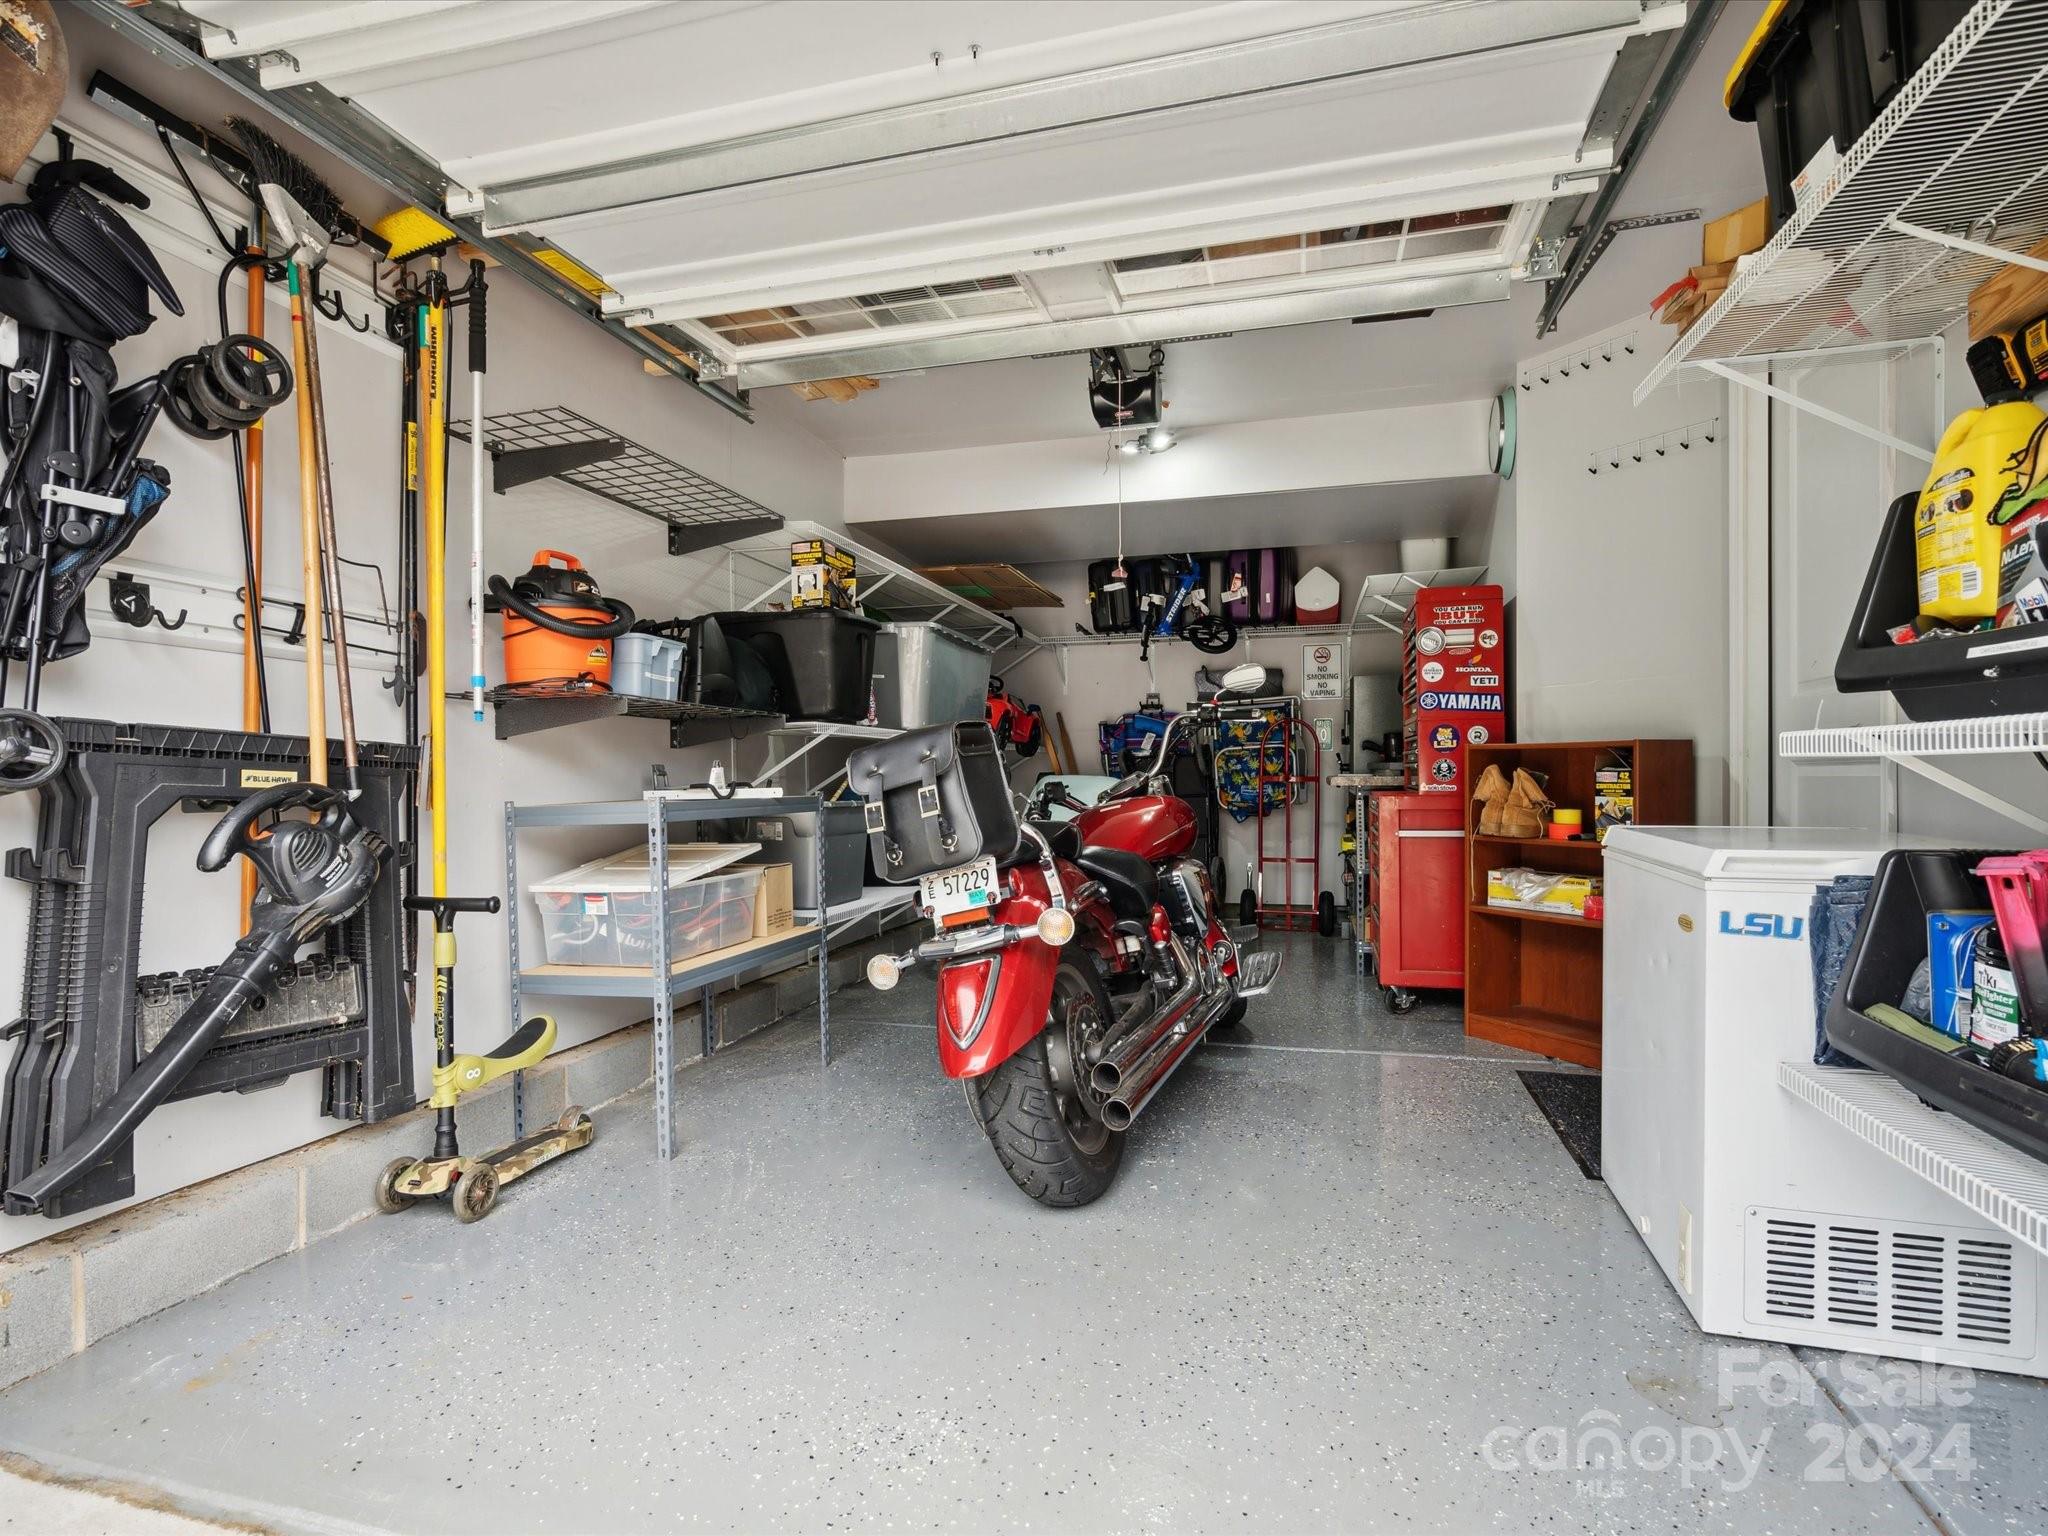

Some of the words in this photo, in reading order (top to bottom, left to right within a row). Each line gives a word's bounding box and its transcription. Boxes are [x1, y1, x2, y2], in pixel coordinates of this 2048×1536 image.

[1165, 587, 1187, 623] STRIDER
[2019, 594, 2045, 608] Mobil
[1439, 611, 1478, 620] BUT
[1306, 673, 1339, 681] SMOKING
[1472, 677, 1497, 685] YETI
[1438, 693, 1502, 710] YAMAHA
[942, 868, 989, 896] 57229
[1719, 911, 1804, 940] LSU
